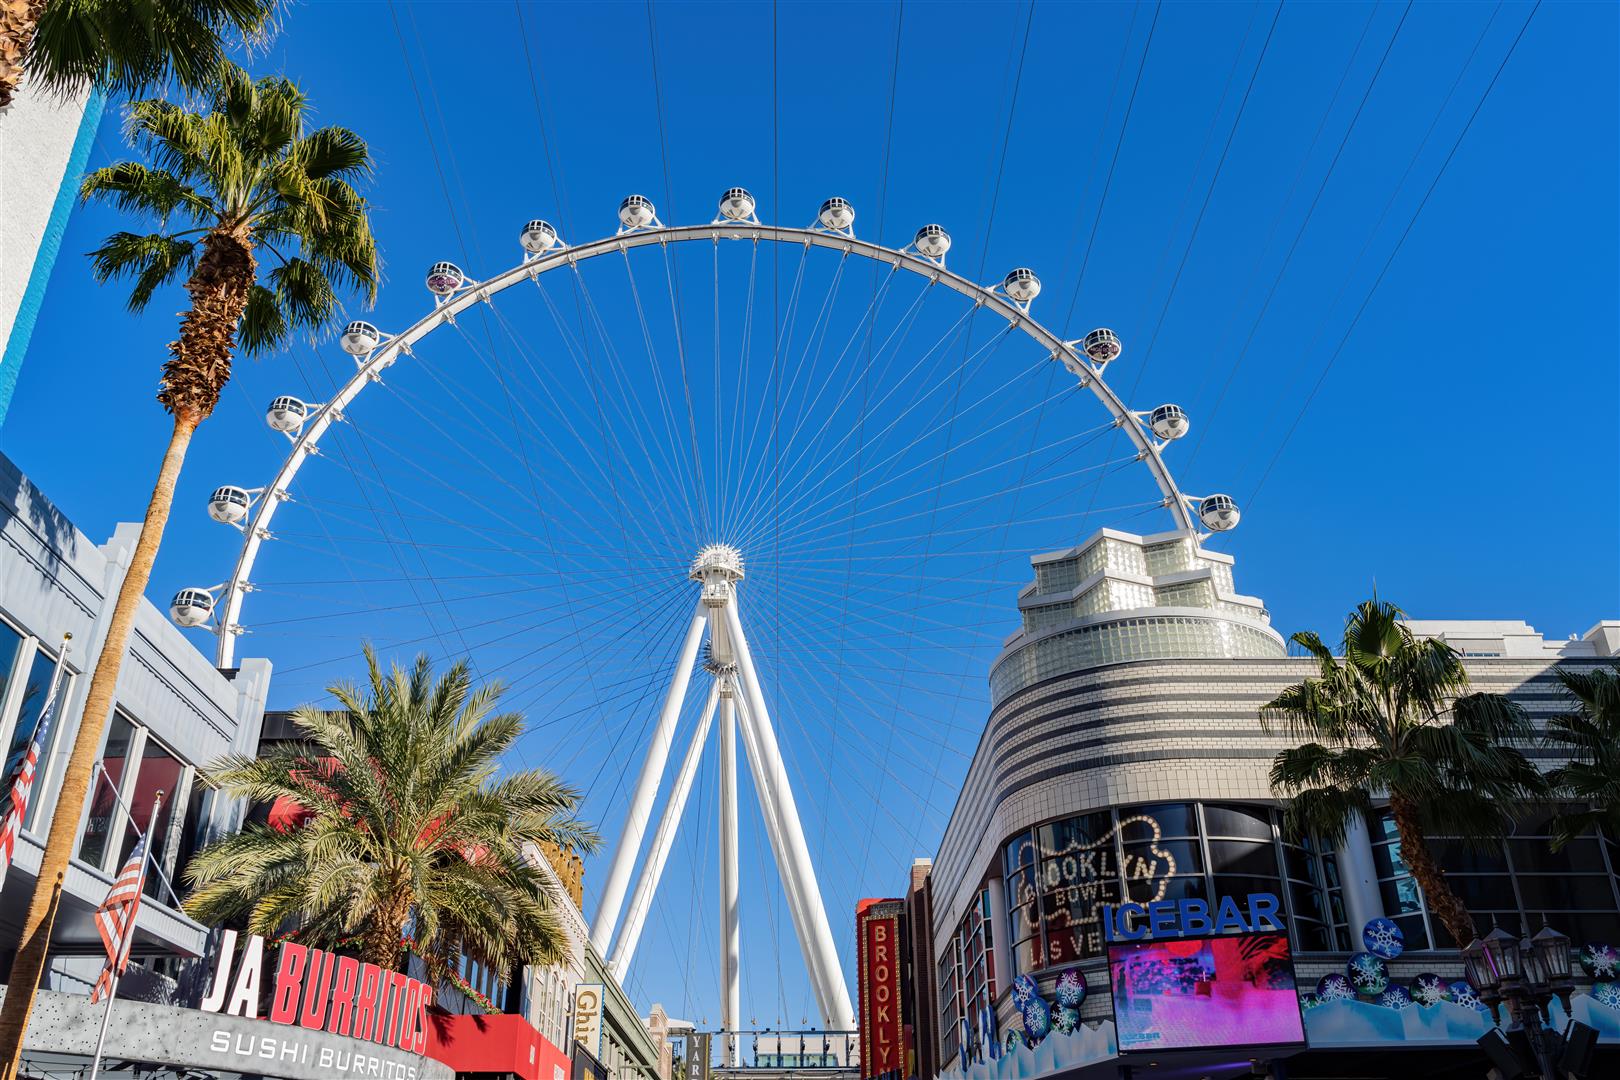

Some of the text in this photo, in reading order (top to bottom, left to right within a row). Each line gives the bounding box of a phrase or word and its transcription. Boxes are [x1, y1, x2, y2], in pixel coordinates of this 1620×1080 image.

[1056, 880, 1113, 906] BOWL
[1103, 893, 1286, 941] ICEBAR
[201, 929, 432, 1055] JA BURRITOS
[874, 925, 890, 1072] BROOKLY
[210, 1031, 416, 1080] SUSHI BURRITOS
[692, 1036, 701, 1080] YAR
